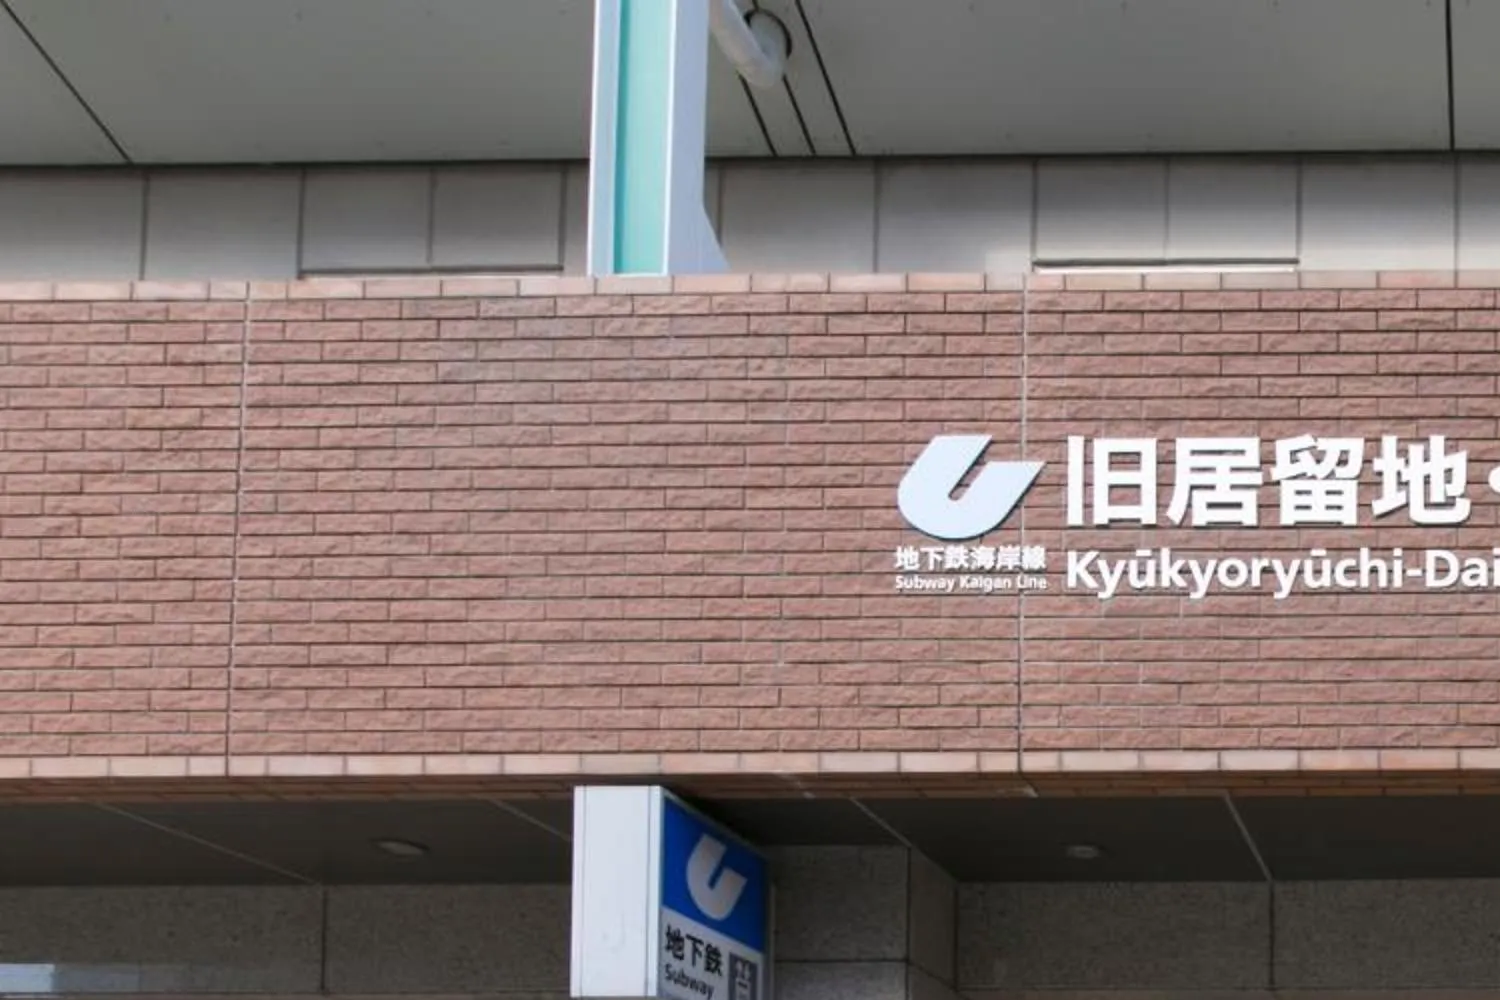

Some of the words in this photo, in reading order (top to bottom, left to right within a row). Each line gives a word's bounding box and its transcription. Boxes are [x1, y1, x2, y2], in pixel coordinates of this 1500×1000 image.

[894, 545, 1047, 571] 地下鉄海岸線
[895, 575, 955, 592] Subway
[959, 575, 1012, 592] Kaigan
[1017, 572, 1047, 589] Line
[665, 924, 723, 977] 地下鉄
[665, 963, 715, 1000] Subway
